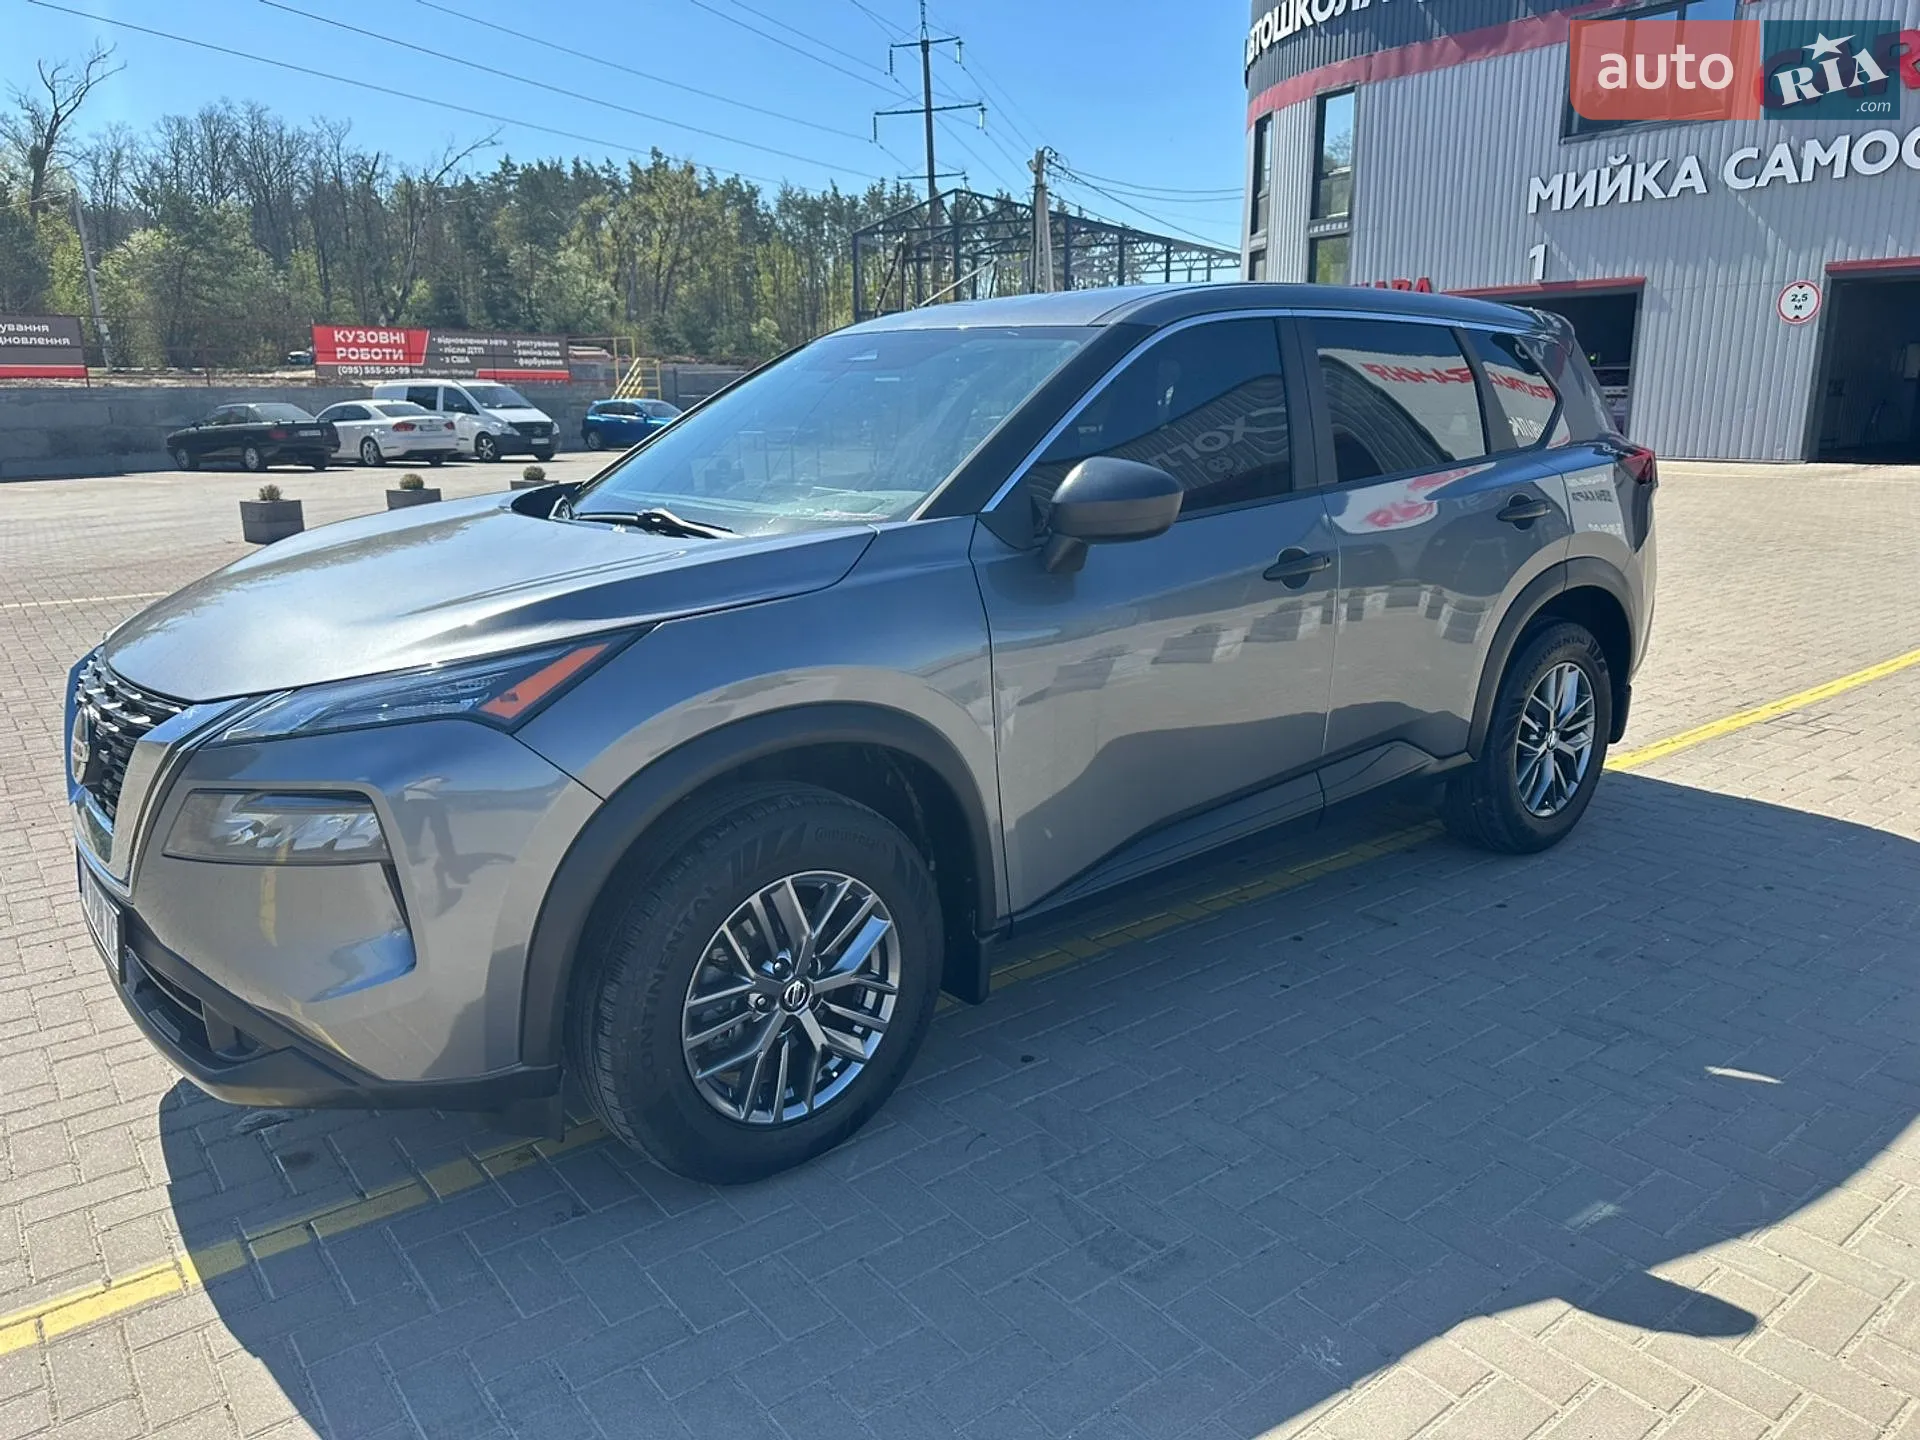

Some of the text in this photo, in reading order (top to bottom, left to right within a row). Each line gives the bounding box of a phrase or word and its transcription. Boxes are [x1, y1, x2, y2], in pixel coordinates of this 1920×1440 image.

[1527, 153, 1708, 215] МИЙКА
[1528, 243, 1548, 281] 1
[1791, 293, 1808, 303] 2,5
[334, 330, 405, 344] КУЗОВНІ
[335, 347, 404, 360] РОБОТИ
